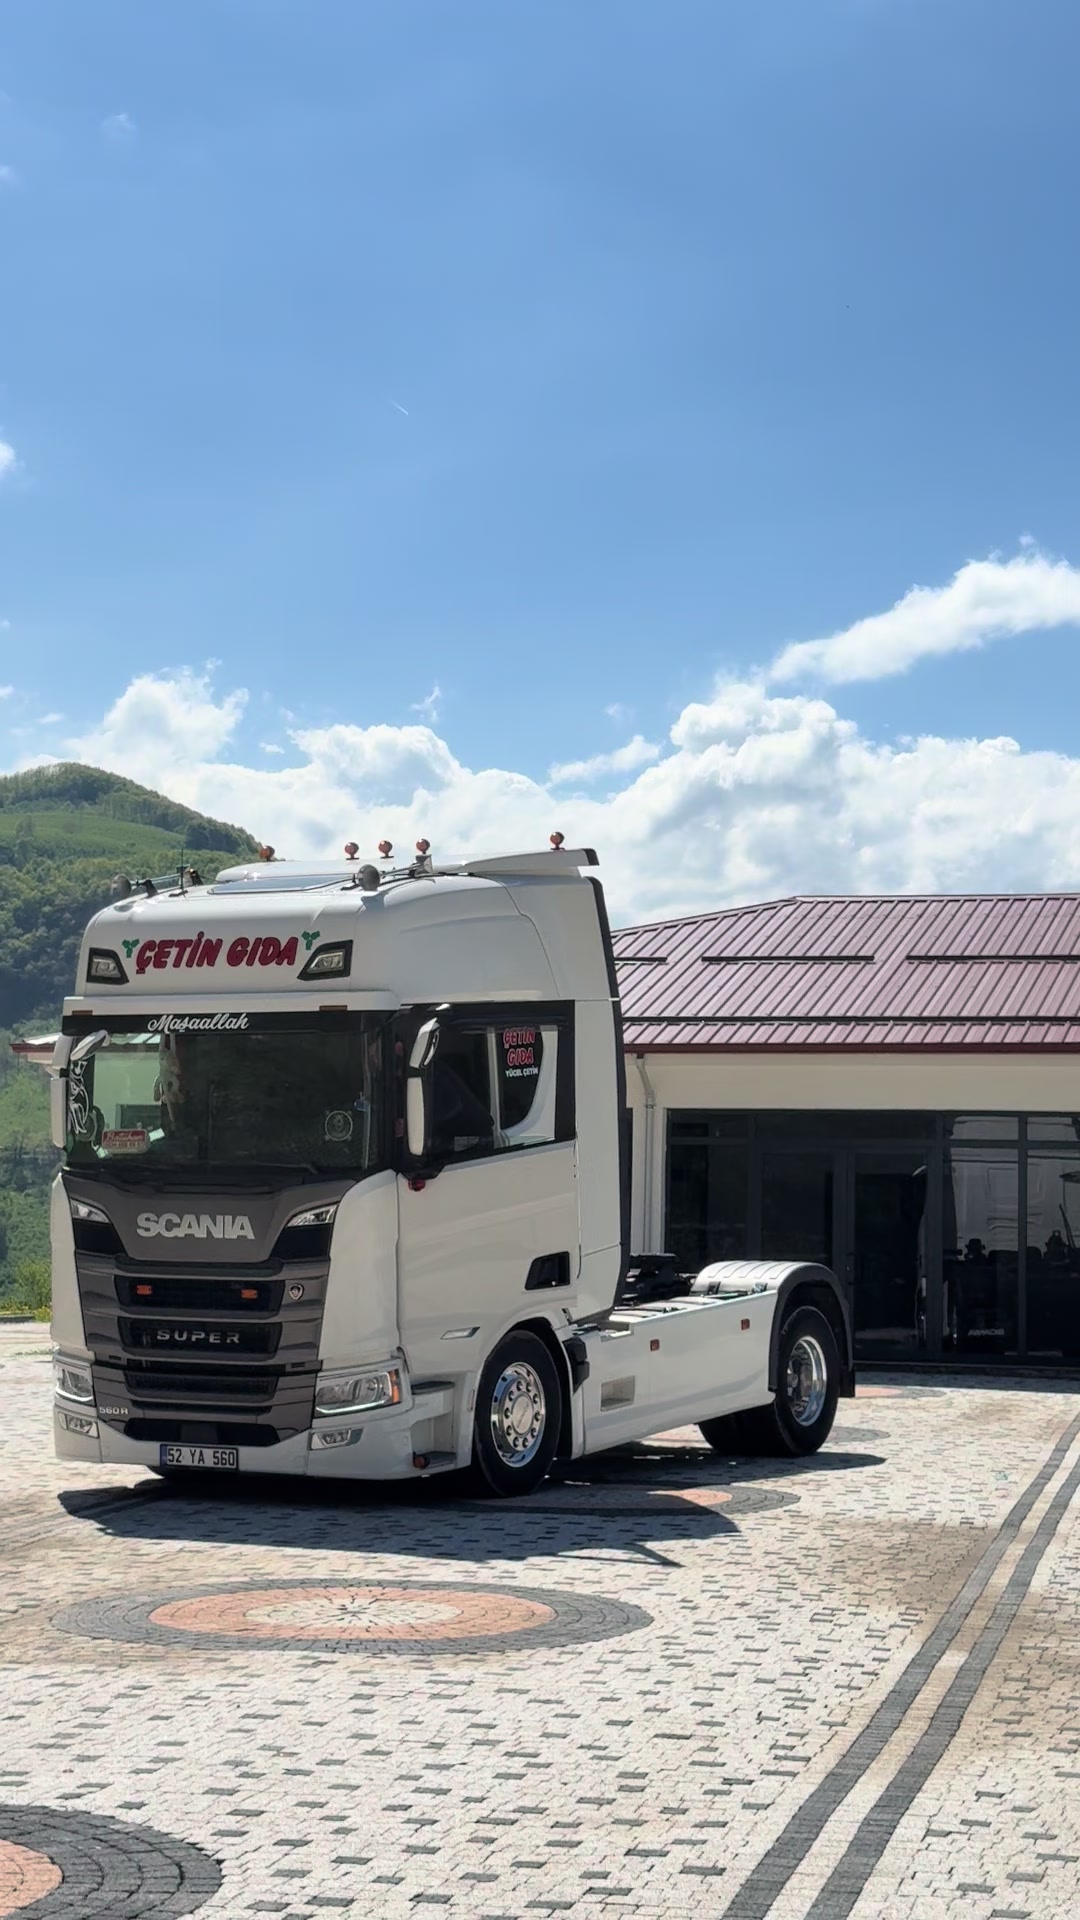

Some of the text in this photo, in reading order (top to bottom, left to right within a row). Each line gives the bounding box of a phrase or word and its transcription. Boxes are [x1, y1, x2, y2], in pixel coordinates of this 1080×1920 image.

[136, 931, 299, 974] ÇETİN GIDA
[147, 1012, 249, 1034] Maşaallah
[503, 1026, 535, 1048] ÇETİN
[507, 1047, 533, 1066] GIDA
[505, 1068, 523, 1077] YÜCEL
[136, 1212, 256, 1240] SCANIA
[157, 1329, 240, 1343] SUPER
[167, 1448, 235, 1466] 52 YA 560
